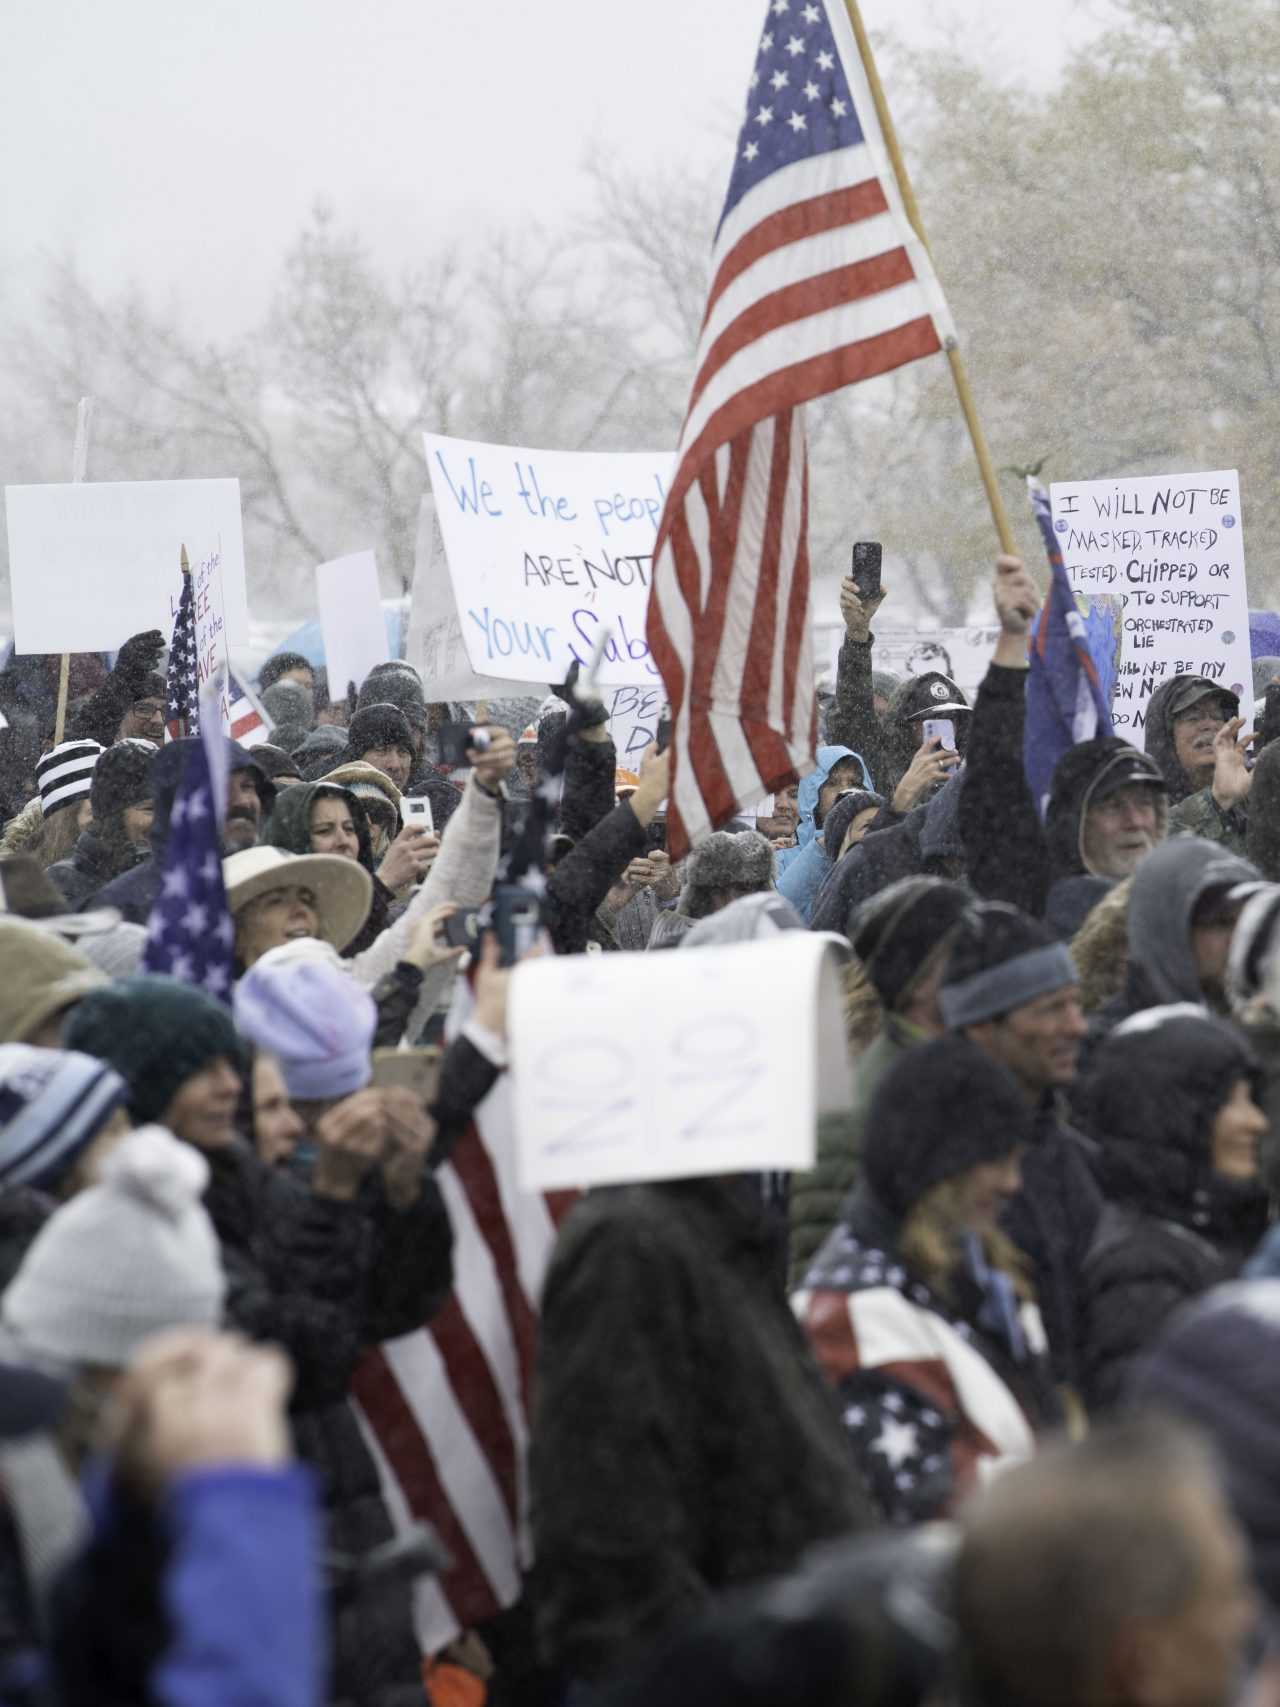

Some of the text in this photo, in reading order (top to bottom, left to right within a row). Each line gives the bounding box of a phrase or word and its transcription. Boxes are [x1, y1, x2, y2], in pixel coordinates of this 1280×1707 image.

[436, 450, 665, 536] We the peopl
[1059, 495, 1080, 513] I
[1151, 488, 1208, 515] NOT
[1210, 488, 1231, 505] BE
[1144, 528, 1218, 551] TRACKED
[524, 550, 653, 588] ARE NOT
[1208, 563, 1230, 579] OR
[1130, 590, 1155, 605] TO
[1161, 589, 1231, 609] SUPPORT
[1124, 617, 1213, 634] ORCHESTRATED
[468, 607, 557, 662] Your
[568, 609, 660, 675] Sub
[1174, 660, 1194, 674] BE
[1111, 681, 1133, 700] EW
